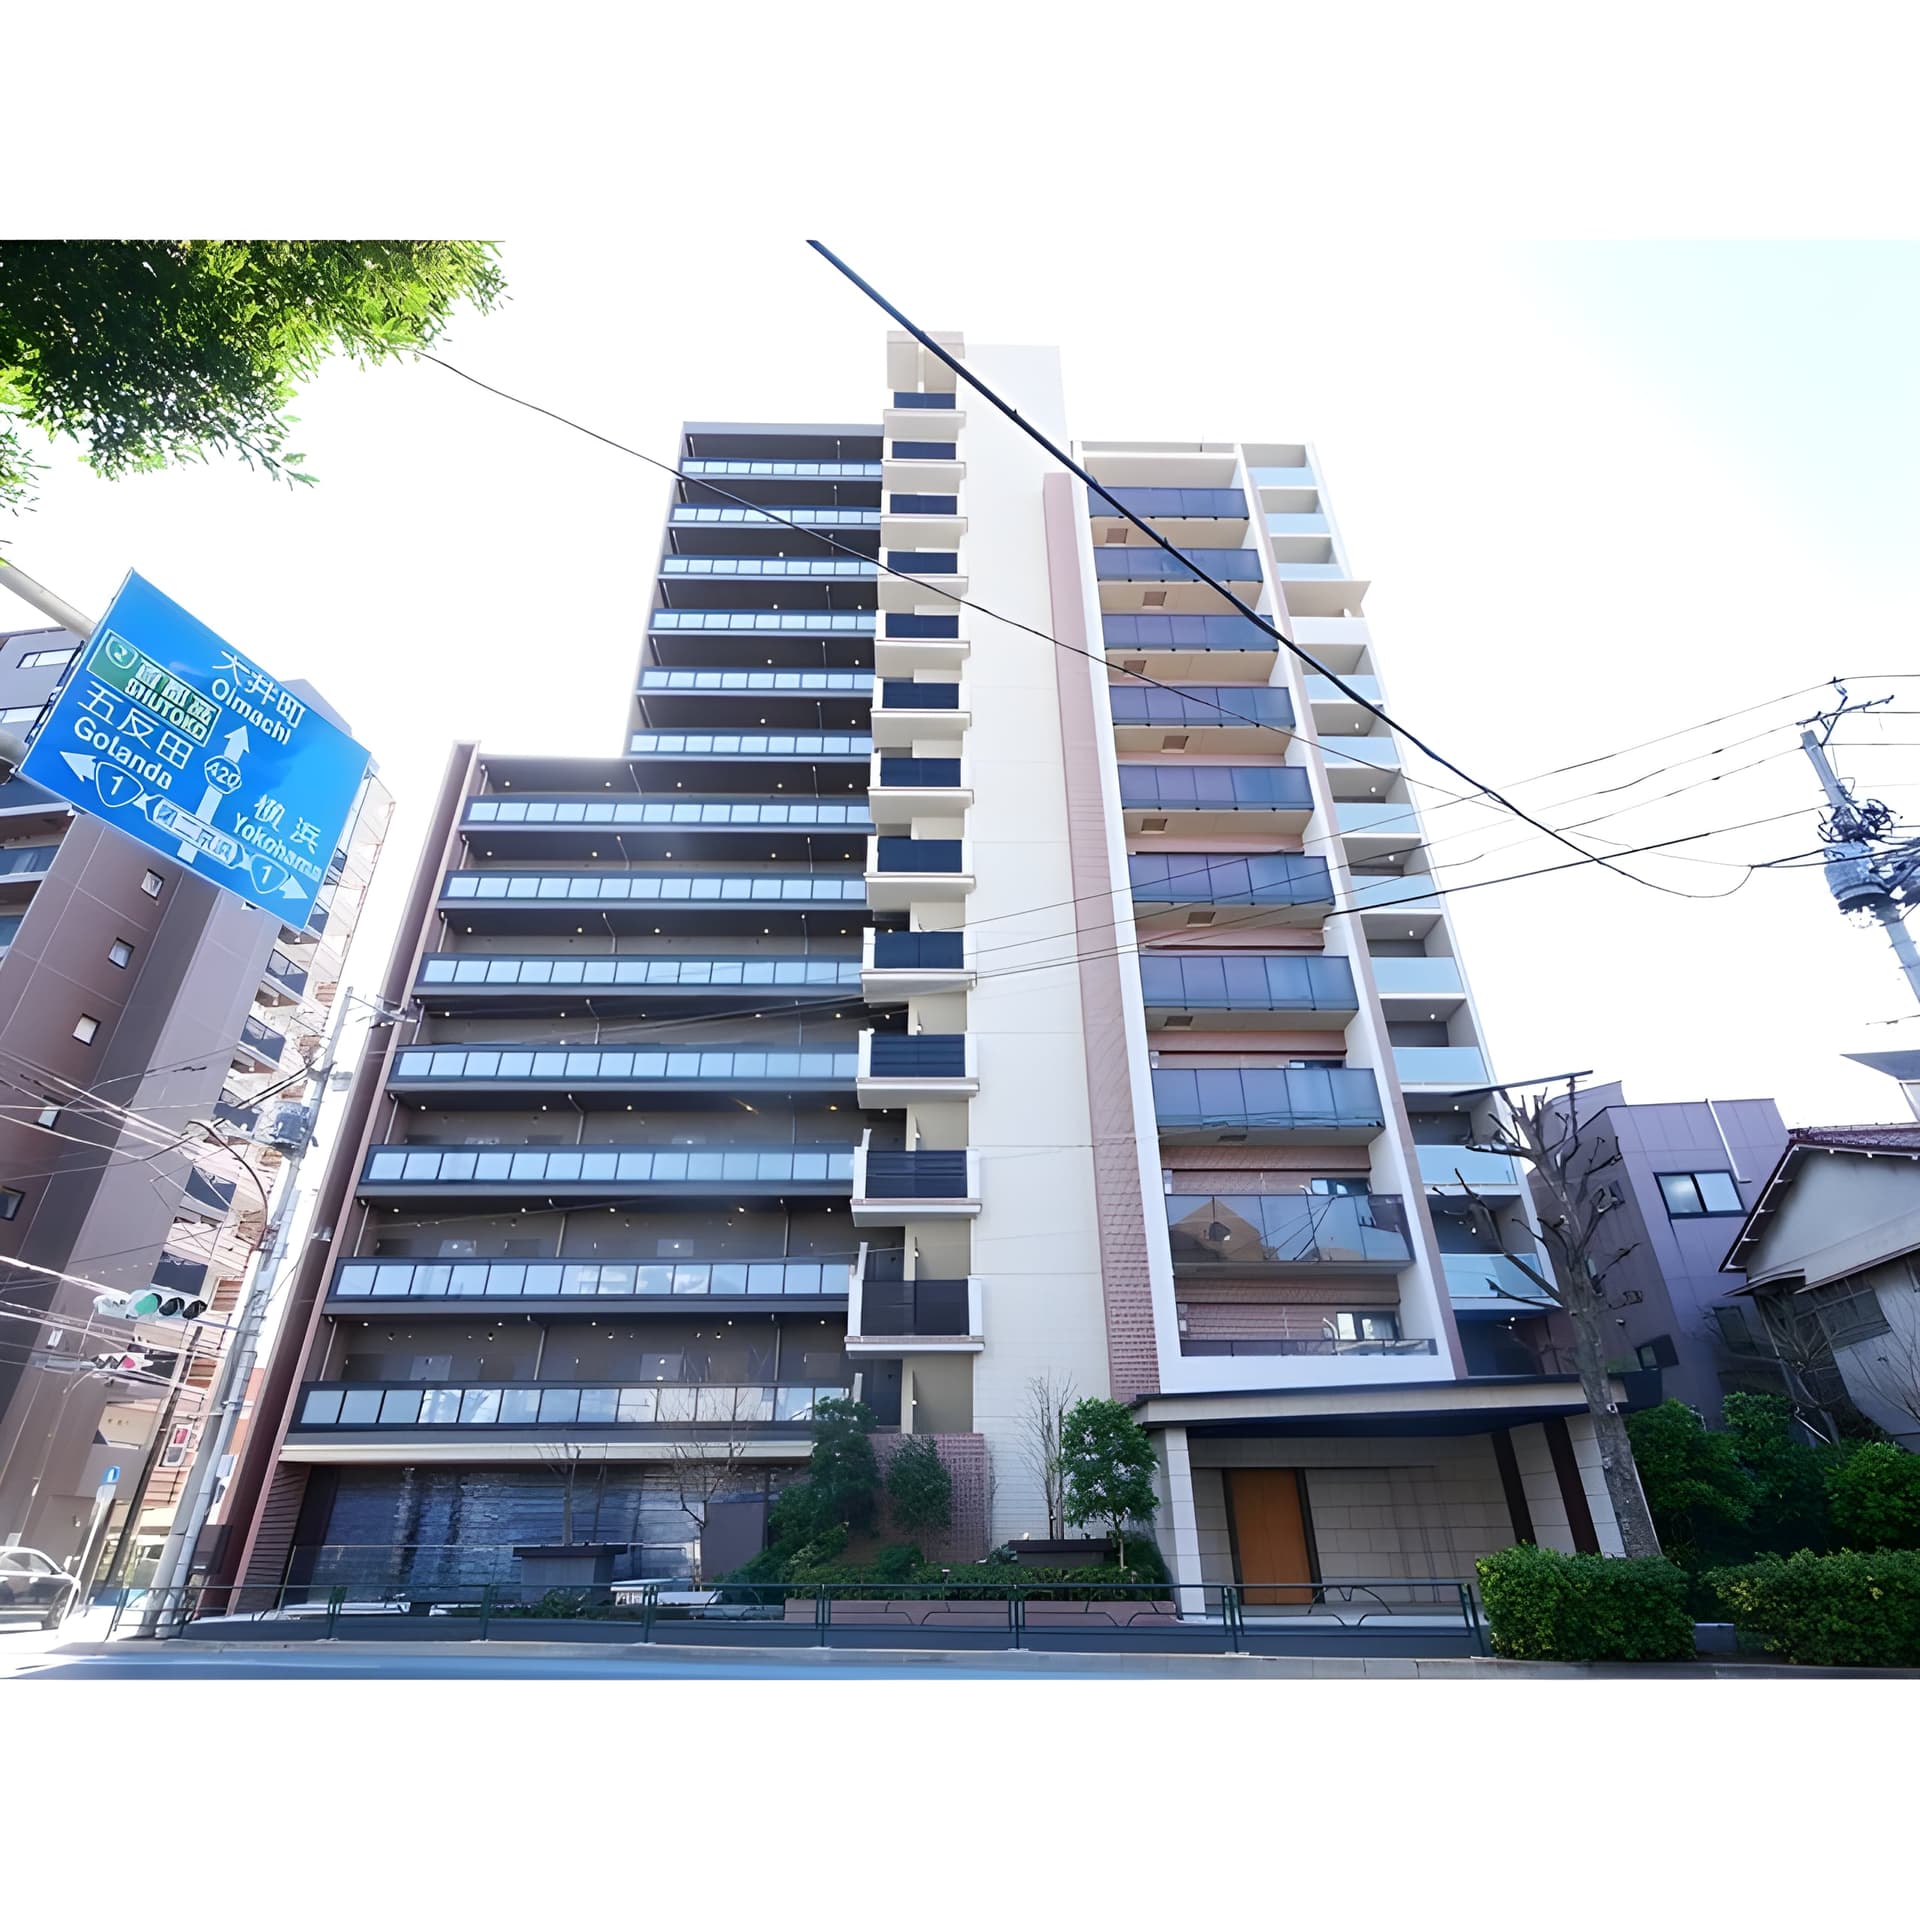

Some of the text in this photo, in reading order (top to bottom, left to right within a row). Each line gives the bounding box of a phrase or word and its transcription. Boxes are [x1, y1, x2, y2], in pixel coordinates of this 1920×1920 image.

[212, 650, 306, 728] 大井町
[77, 680, 194, 770] 五反田
[111, 775, 124, 796] 1
[233, 812, 322, 882] Yokohama
[261, 865, 273, 885] 1
